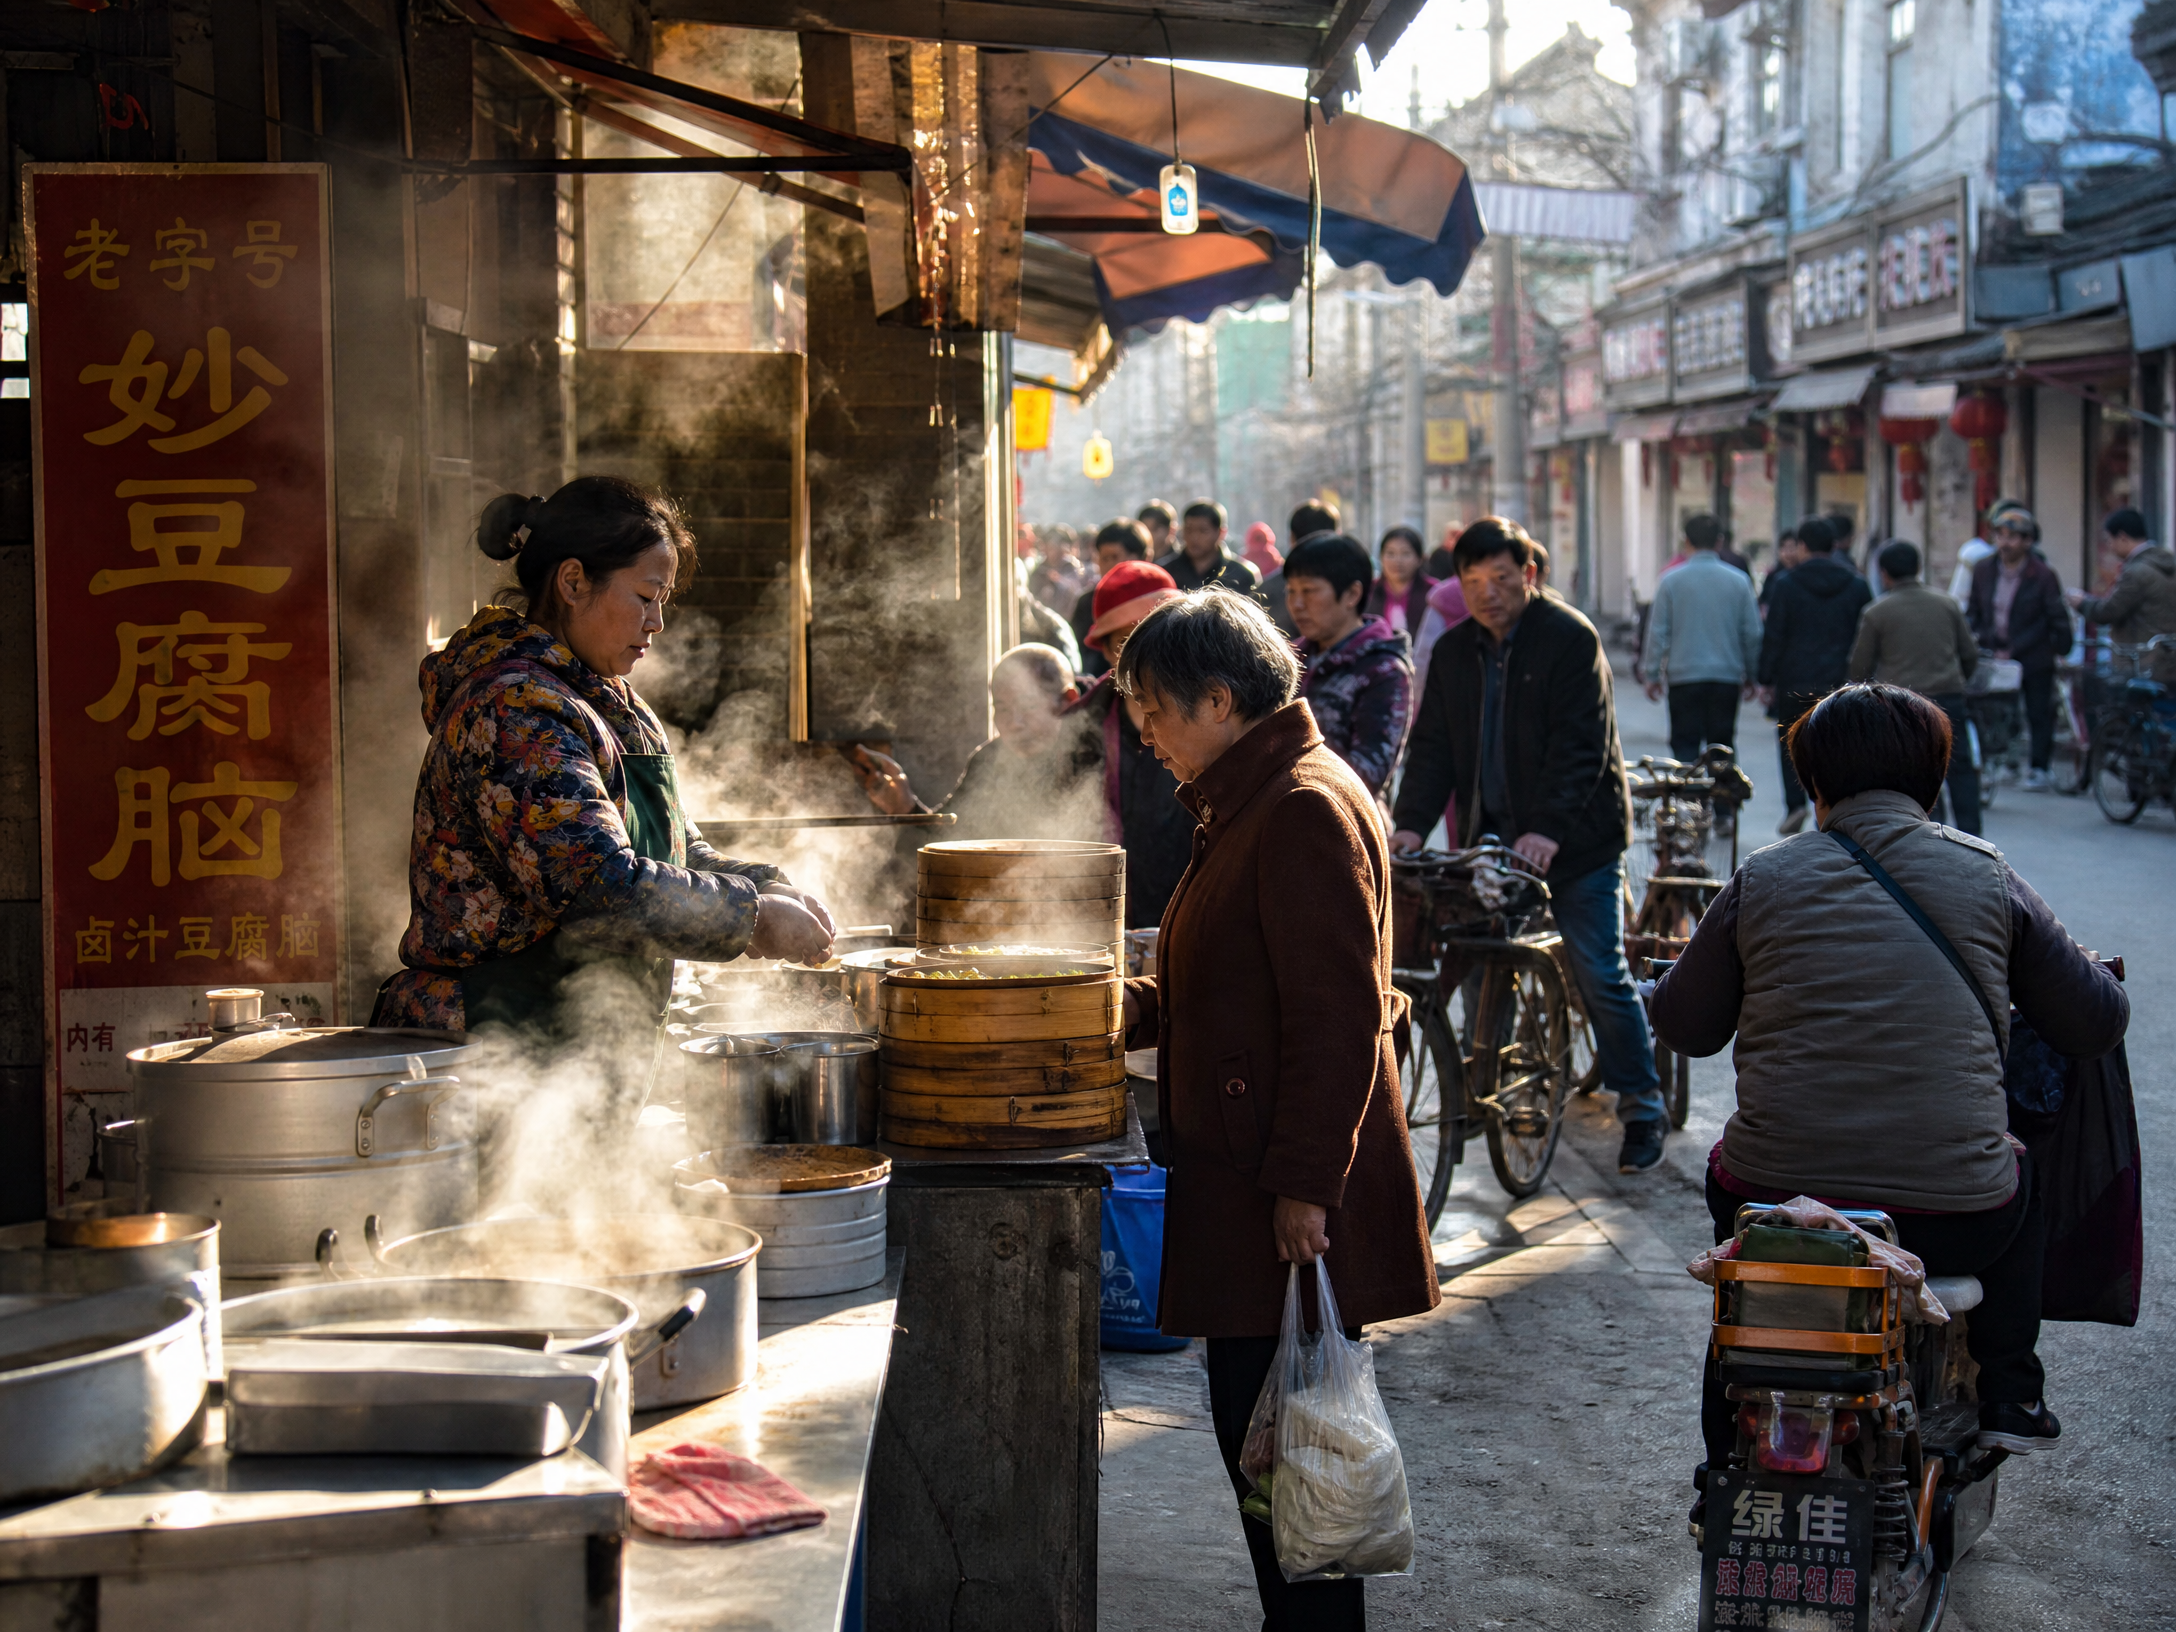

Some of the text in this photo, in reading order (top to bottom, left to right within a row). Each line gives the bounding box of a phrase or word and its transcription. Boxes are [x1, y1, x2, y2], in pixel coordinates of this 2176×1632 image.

[63, 216, 298, 291] 老字号
[78, 326, 299, 887] 妙豆腐脑
[74, 911, 322, 965] 卤汁豆腐脑
[66, 1021, 116, 1054] 内有
[1731, 1489, 1847, 1544] 绿佳
